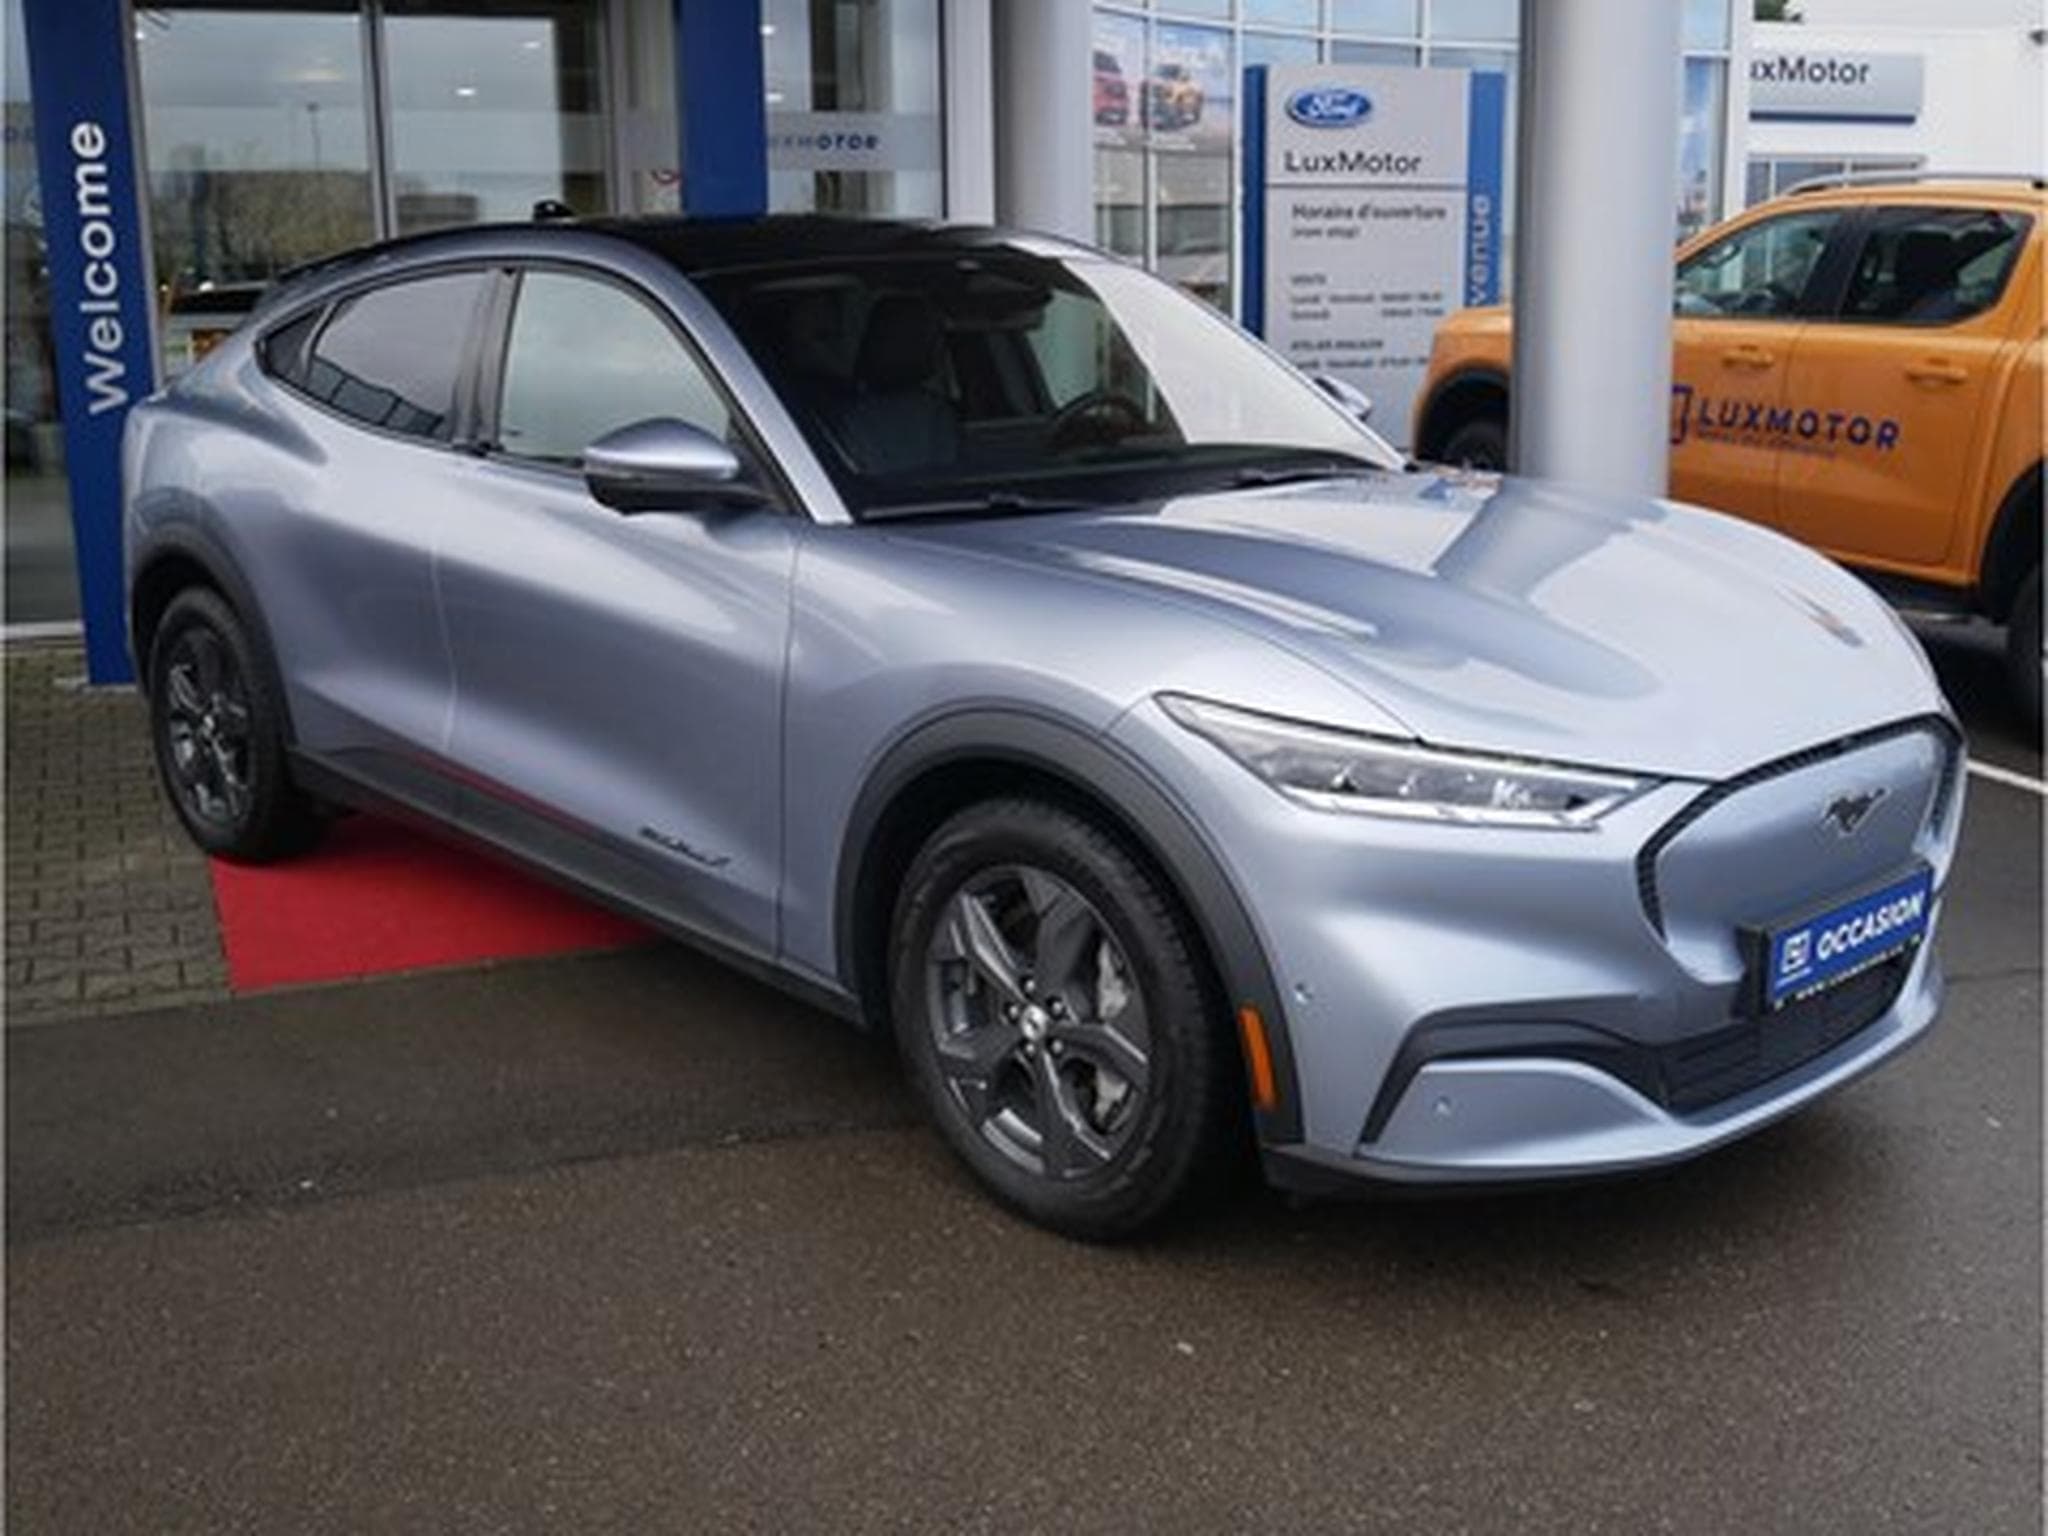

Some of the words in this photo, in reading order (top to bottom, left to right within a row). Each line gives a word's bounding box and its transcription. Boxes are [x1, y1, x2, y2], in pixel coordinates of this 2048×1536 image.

[1284, 151, 1422, 174] LuxMotor
[1292, 204, 1354, 220] Horaire
[71, 121, 129, 415] Welcome
[1698, 397, 1900, 449] LUXMOTOR
[1817, 890, 1926, 961] OCCASION
